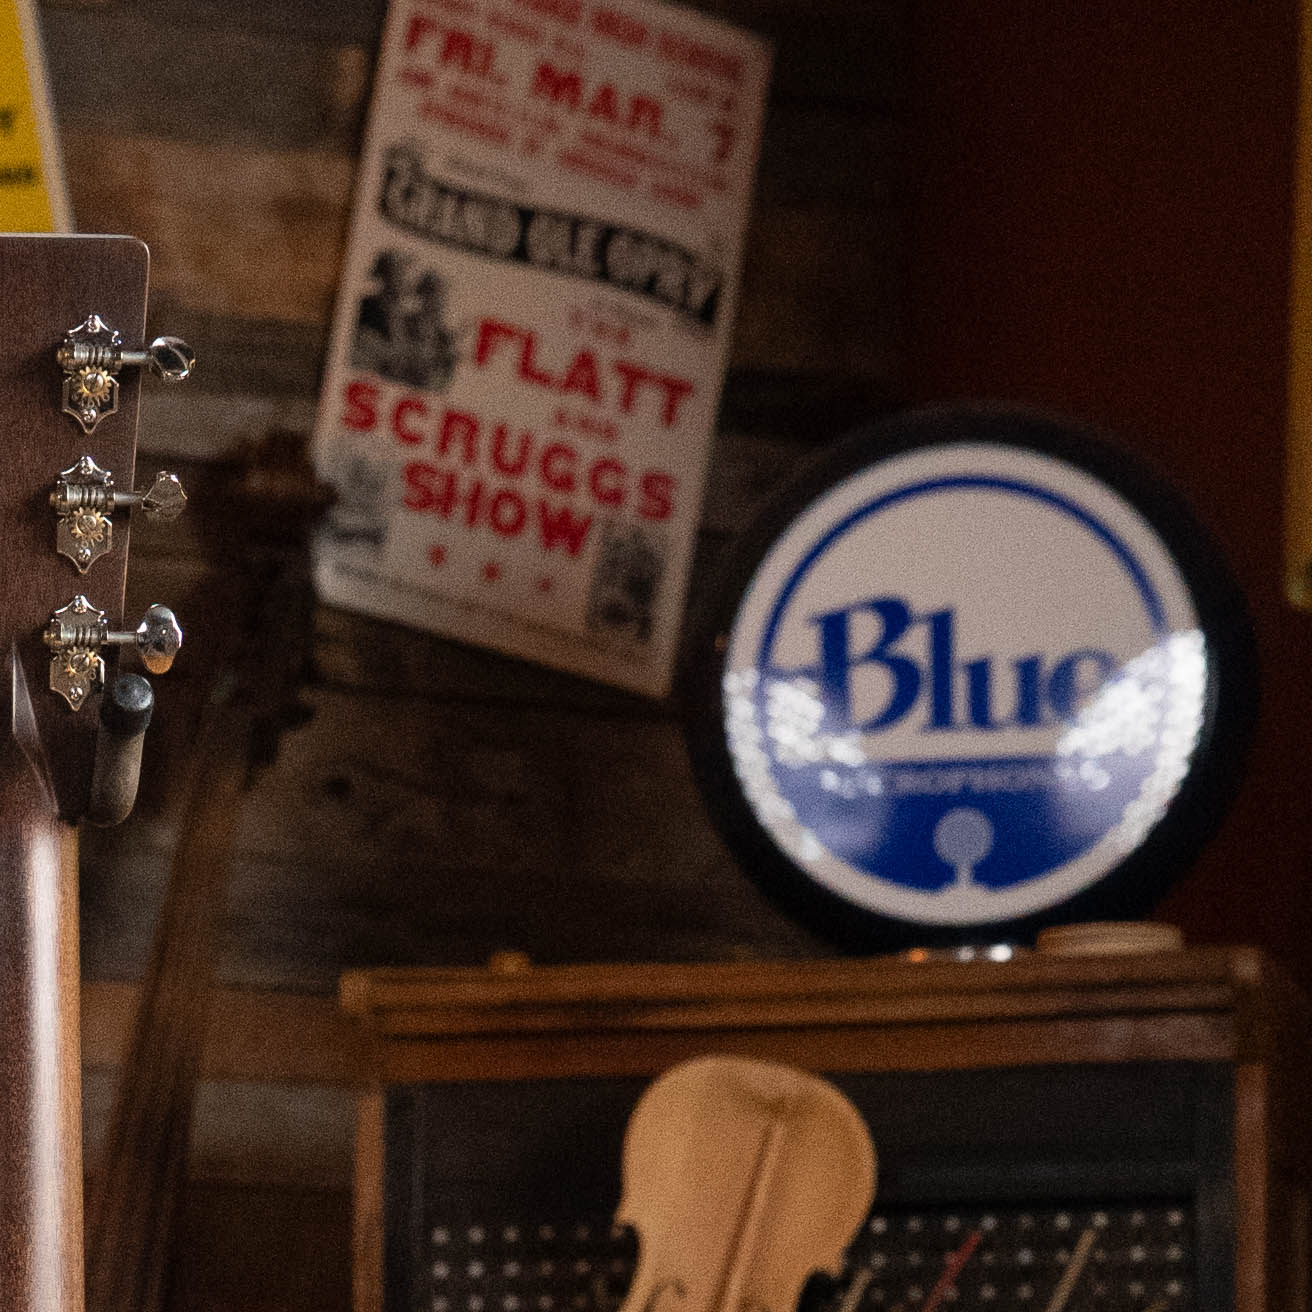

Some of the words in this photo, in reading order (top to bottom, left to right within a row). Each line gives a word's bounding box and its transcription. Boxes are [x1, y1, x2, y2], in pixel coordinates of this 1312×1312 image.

[475, 317, 694, 427] FLATT
[341, 380, 678, 522] SCRUGGS
[402, 461, 592, 557] SHOW
